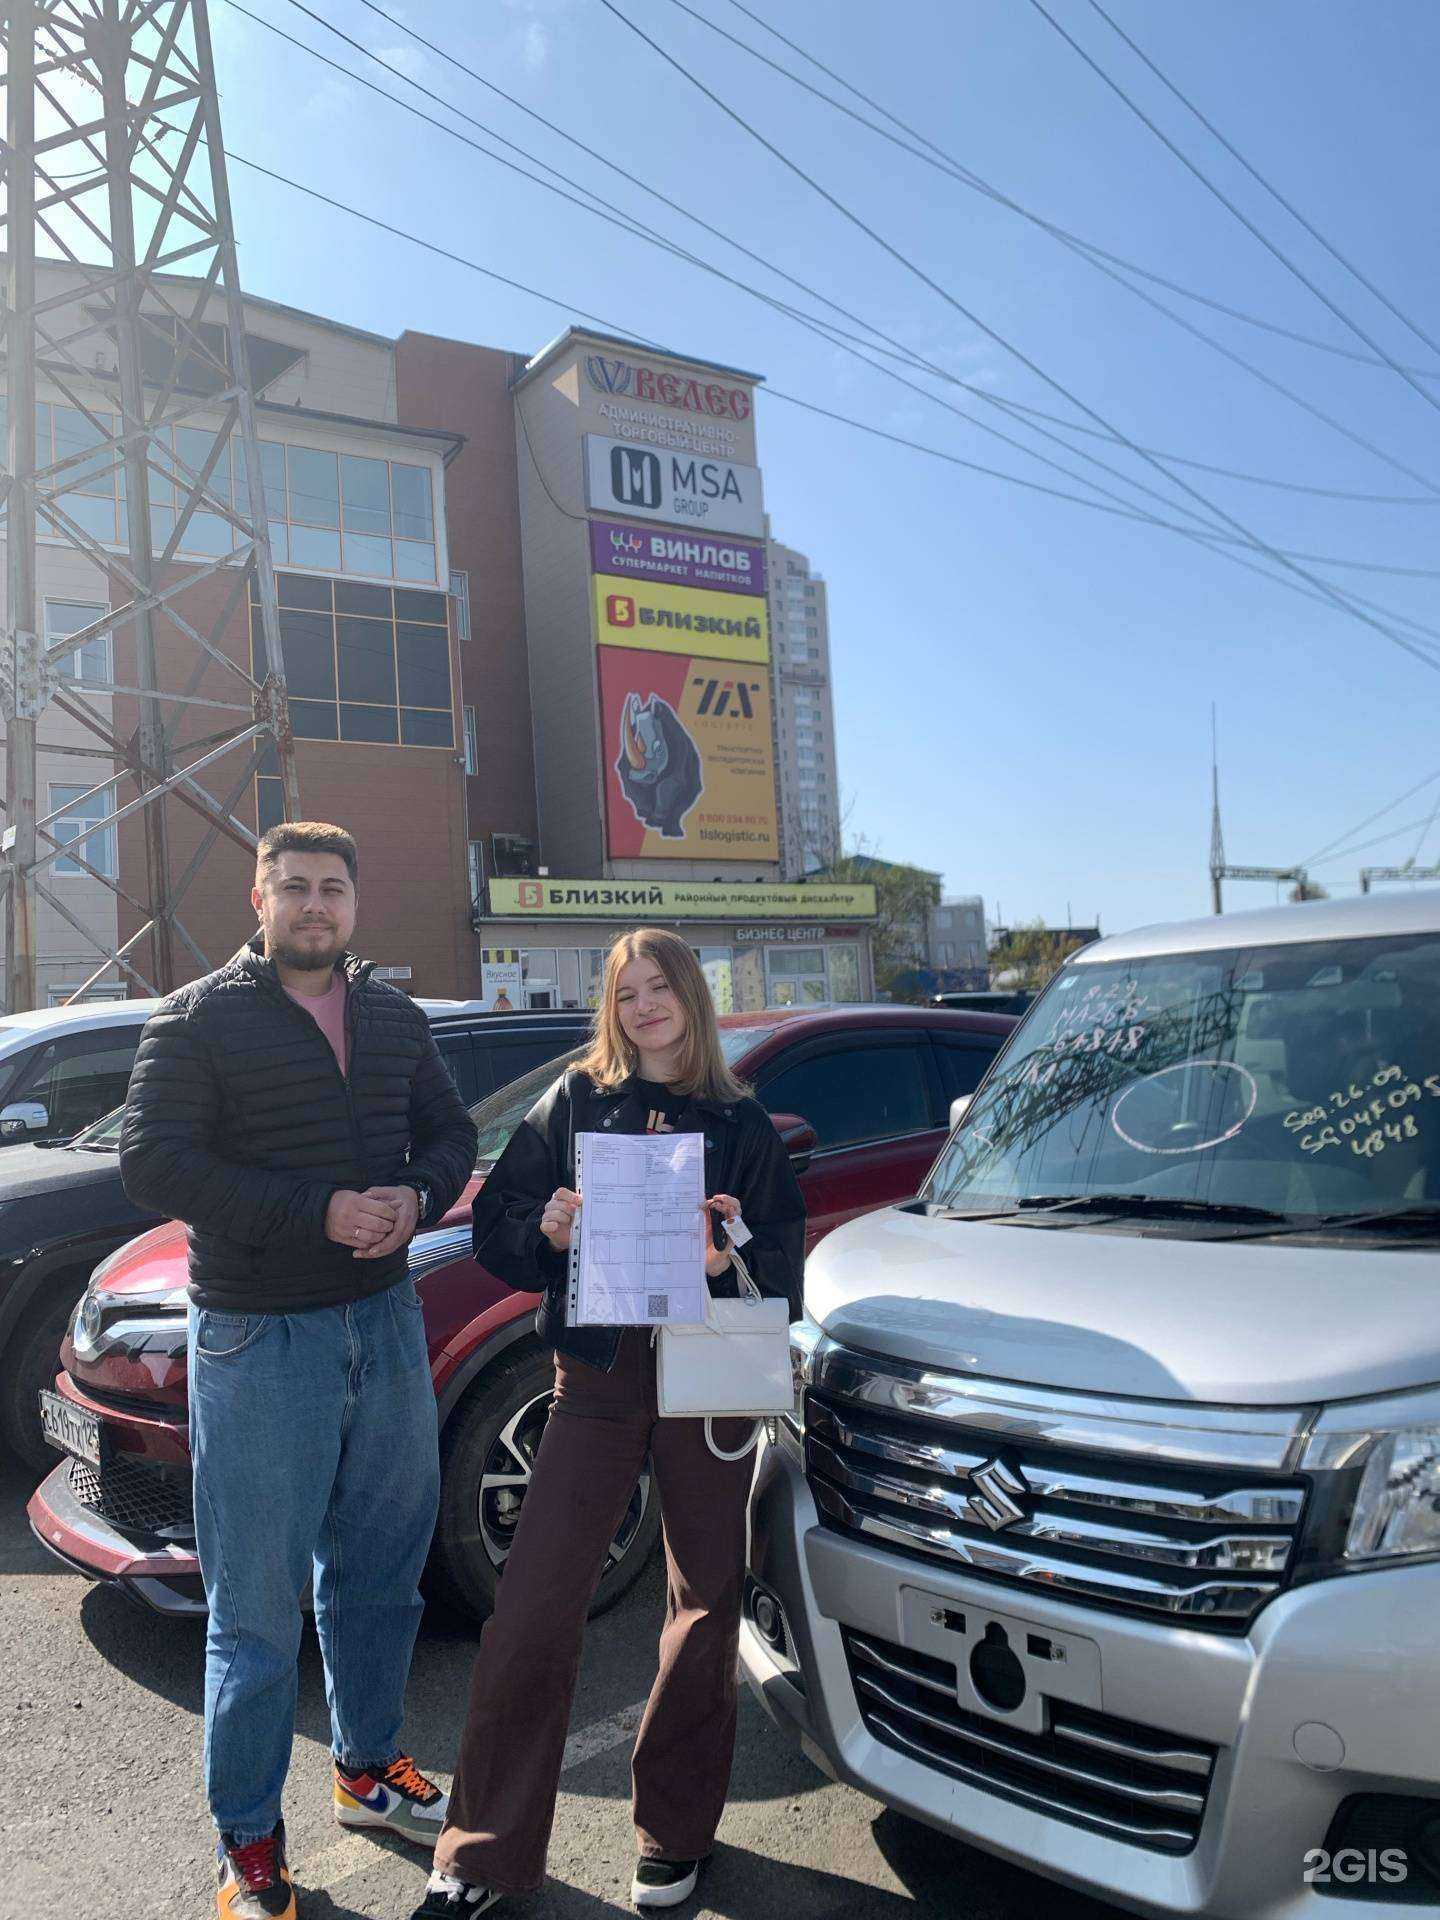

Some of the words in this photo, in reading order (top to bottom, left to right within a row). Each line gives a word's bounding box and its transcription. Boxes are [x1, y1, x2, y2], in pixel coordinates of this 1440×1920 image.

[672, 456, 742, 503] MSA
[673, 497, 709, 517] GROUP
[650, 537, 751, 571] ВИНЛАБ
[611, 556, 689, 576] СУПЕРМАРКЕТ
[695, 568, 752, 586] НАПИТКОВ
[638, 605, 762, 640] БЛИЗКИЙ
[700, 829, 770, 843] tislogistic.ru
[549, 885, 664, 905] БЛИЗКИЙ
[736, 927, 785, 941] БИЗНЕС
[787, 927, 825, 942] ЦЕНТР
